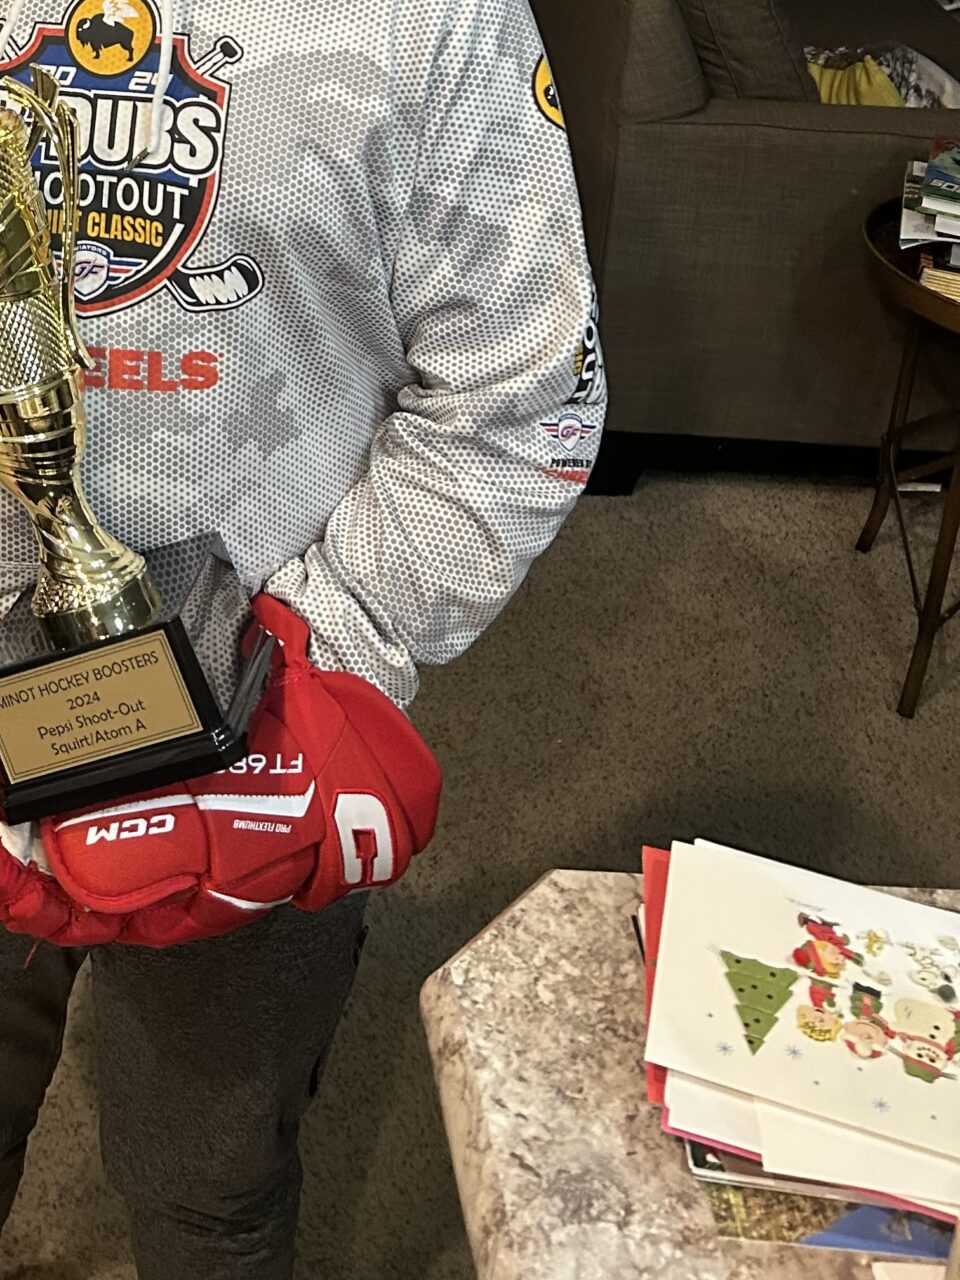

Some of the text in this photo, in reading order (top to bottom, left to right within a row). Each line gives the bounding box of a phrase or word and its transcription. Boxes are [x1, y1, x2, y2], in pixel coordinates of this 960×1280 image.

[88, 211, 164, 247] CLASSIC
[39, 669, 89, 697] HOCKEY
[94, 650, 159, 682] BOOSTERS
[66, 691, 101, 711] 2024
[38, 699, 146, 740] Pepsi Shoot-Out
[51, 719, 147, 756] Squirt/Atom A
[85, 813, 177, 846] CCM
[233, 819, 292, 833] PRO FLEXTHUMB
